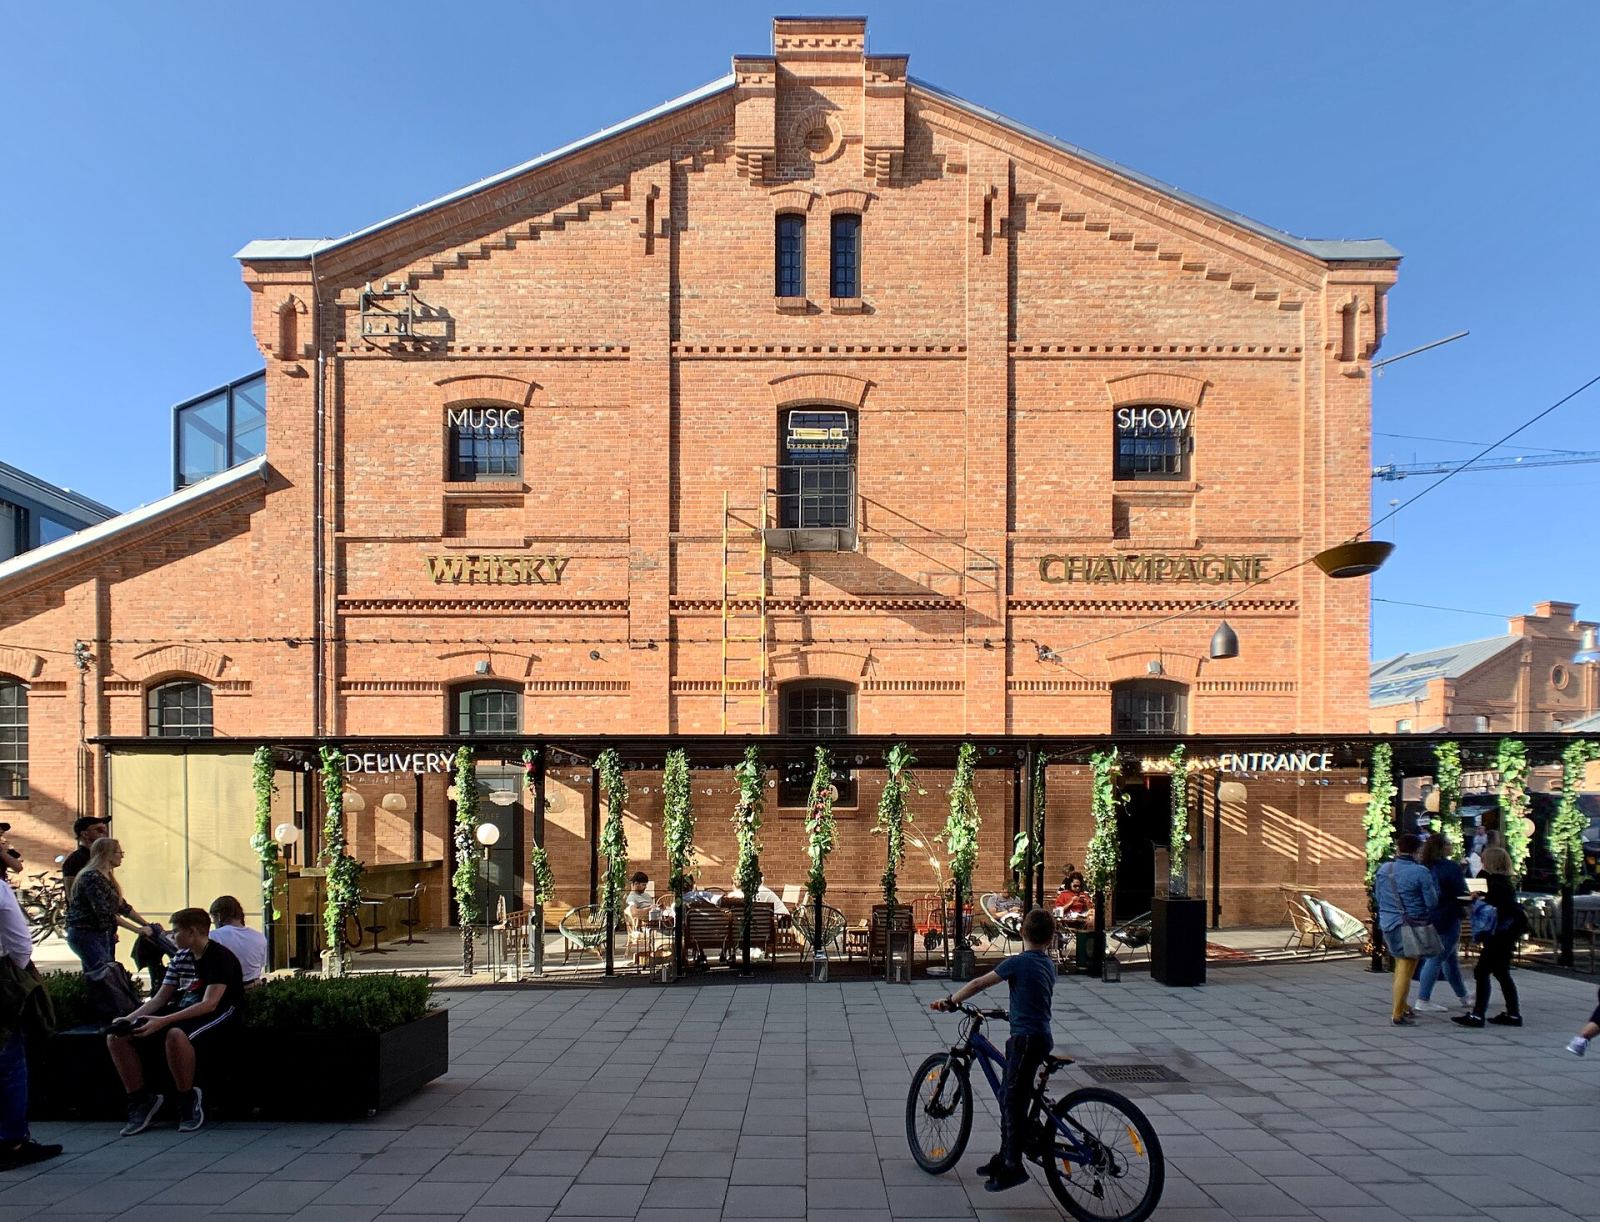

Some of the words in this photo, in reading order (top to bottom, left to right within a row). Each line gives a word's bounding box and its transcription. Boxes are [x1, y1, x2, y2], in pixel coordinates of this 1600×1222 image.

[447, 408, 520, 429] MUSIC
[1117, 408, 1191, 430] SHOW
[423, 554, 567, 584] WHISKY
[1039, 553, 1270, 585] CHAMPAGNE
[345, 753, 456, 774] DELIVERY
[1220, 752, 1334, 773] ENTRANCE
